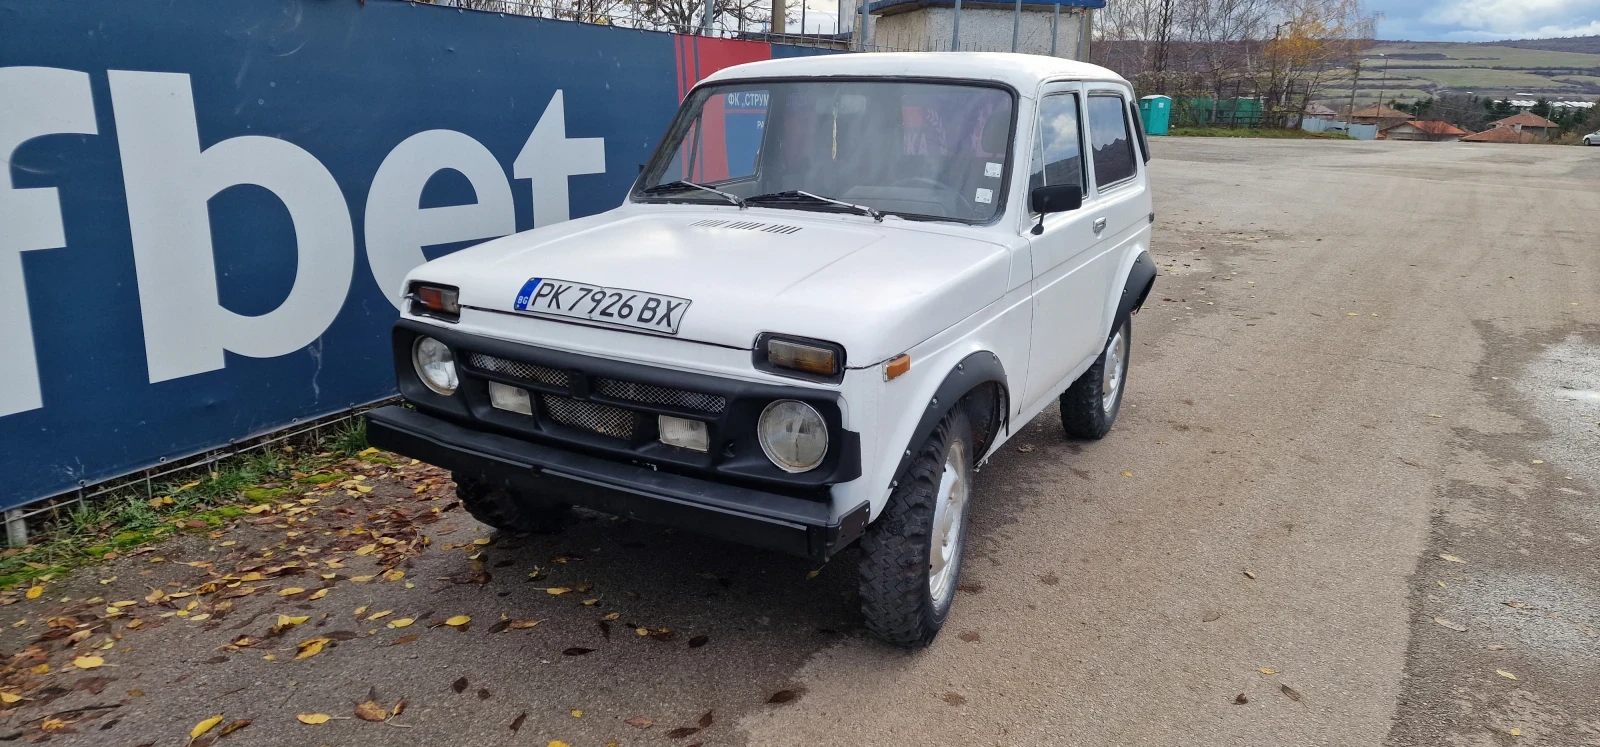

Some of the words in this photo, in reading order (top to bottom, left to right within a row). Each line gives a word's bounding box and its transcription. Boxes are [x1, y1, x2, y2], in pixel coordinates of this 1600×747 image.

[728, 93, 740, 106] ФК
[517, 296, 529, 305] BG
[531, 282, 573, 310] PK
[568, 287, 638, 319] 7926
[637, 297, 683, 328] BX
